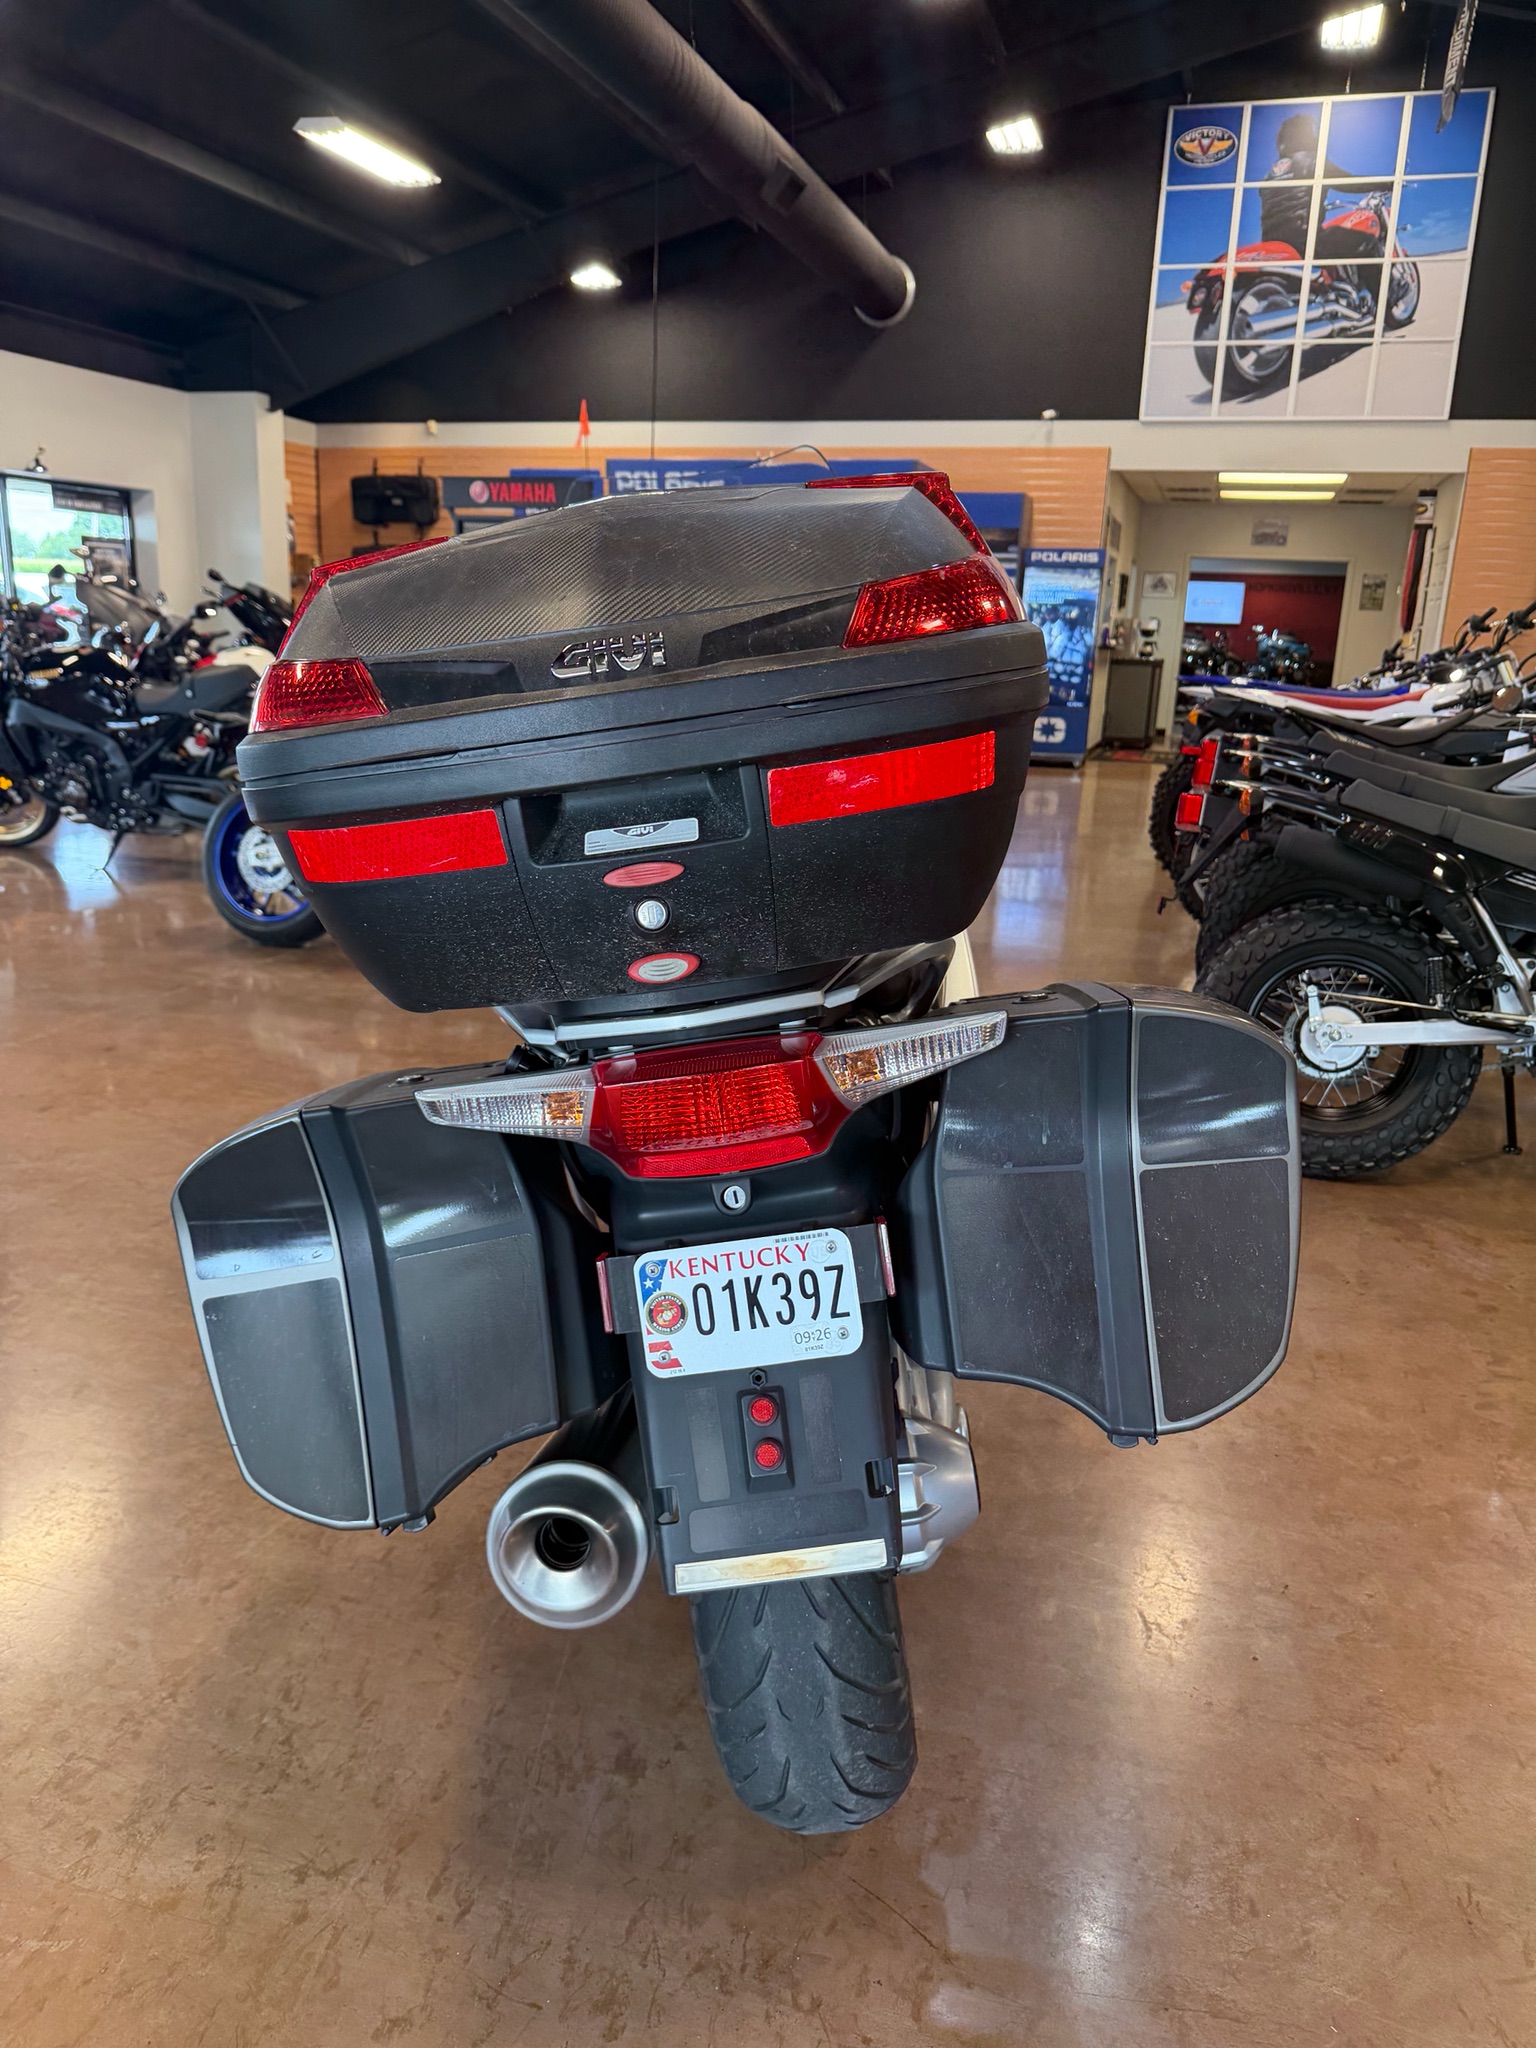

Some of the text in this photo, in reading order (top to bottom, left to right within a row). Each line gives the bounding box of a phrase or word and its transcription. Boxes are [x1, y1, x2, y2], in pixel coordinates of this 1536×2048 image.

[1185, 128, 1230, 142] VICTORY
[488, 482, 556, 504] YAMAHA
[1030, 551, 1099, 564] POLARIS
[551, 631, 667, 679] GIVI
[627, 825, 654, 836] GIVI
[669, 1242, 809, 1279] KENTUCKY
[692, 1264, 850, 1336] 01K39Z
[794, 1331, 811, 1345] 09
[815, 1327, 831, 1341] 26
